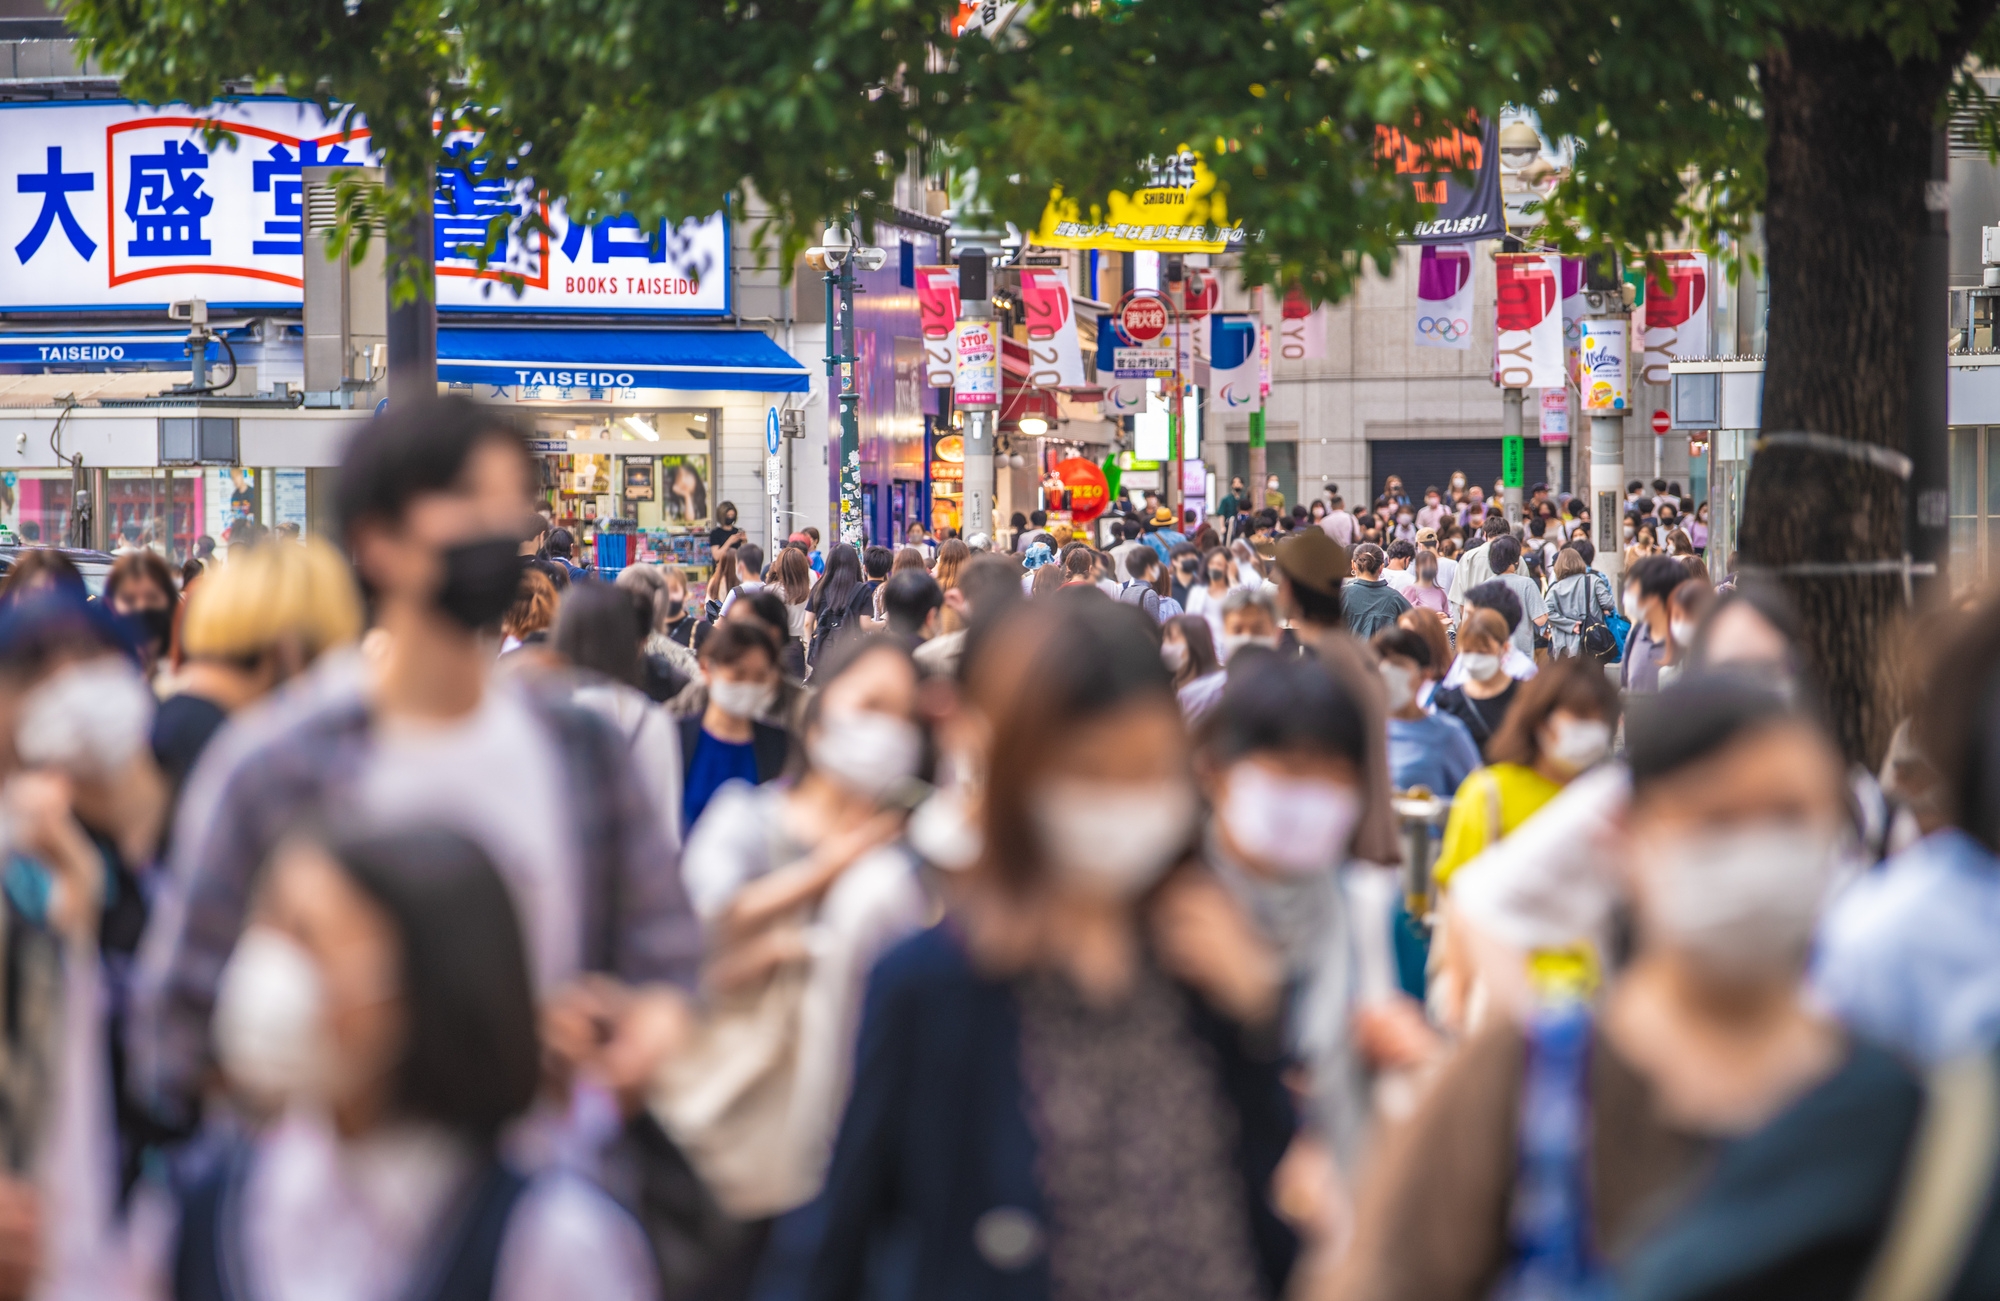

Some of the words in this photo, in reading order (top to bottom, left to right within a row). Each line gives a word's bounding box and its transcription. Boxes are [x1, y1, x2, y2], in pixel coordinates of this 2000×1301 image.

[1143, 192, 1185, 205] SHIBUYA
[566, 277, 618, 293] BOOKS
[627, 277, 698, 296] TAISEIDO
[1126, 310, 1163, 330] 消火栓
[920, 300, 954, 388] 2020
[960, 333, 989, 348] STOP
[1024, 300, 1061, 388] 2020
[38, 345, 125, 361] TAISEIDO
[515, 370, 635, 387] TAISEIDO
